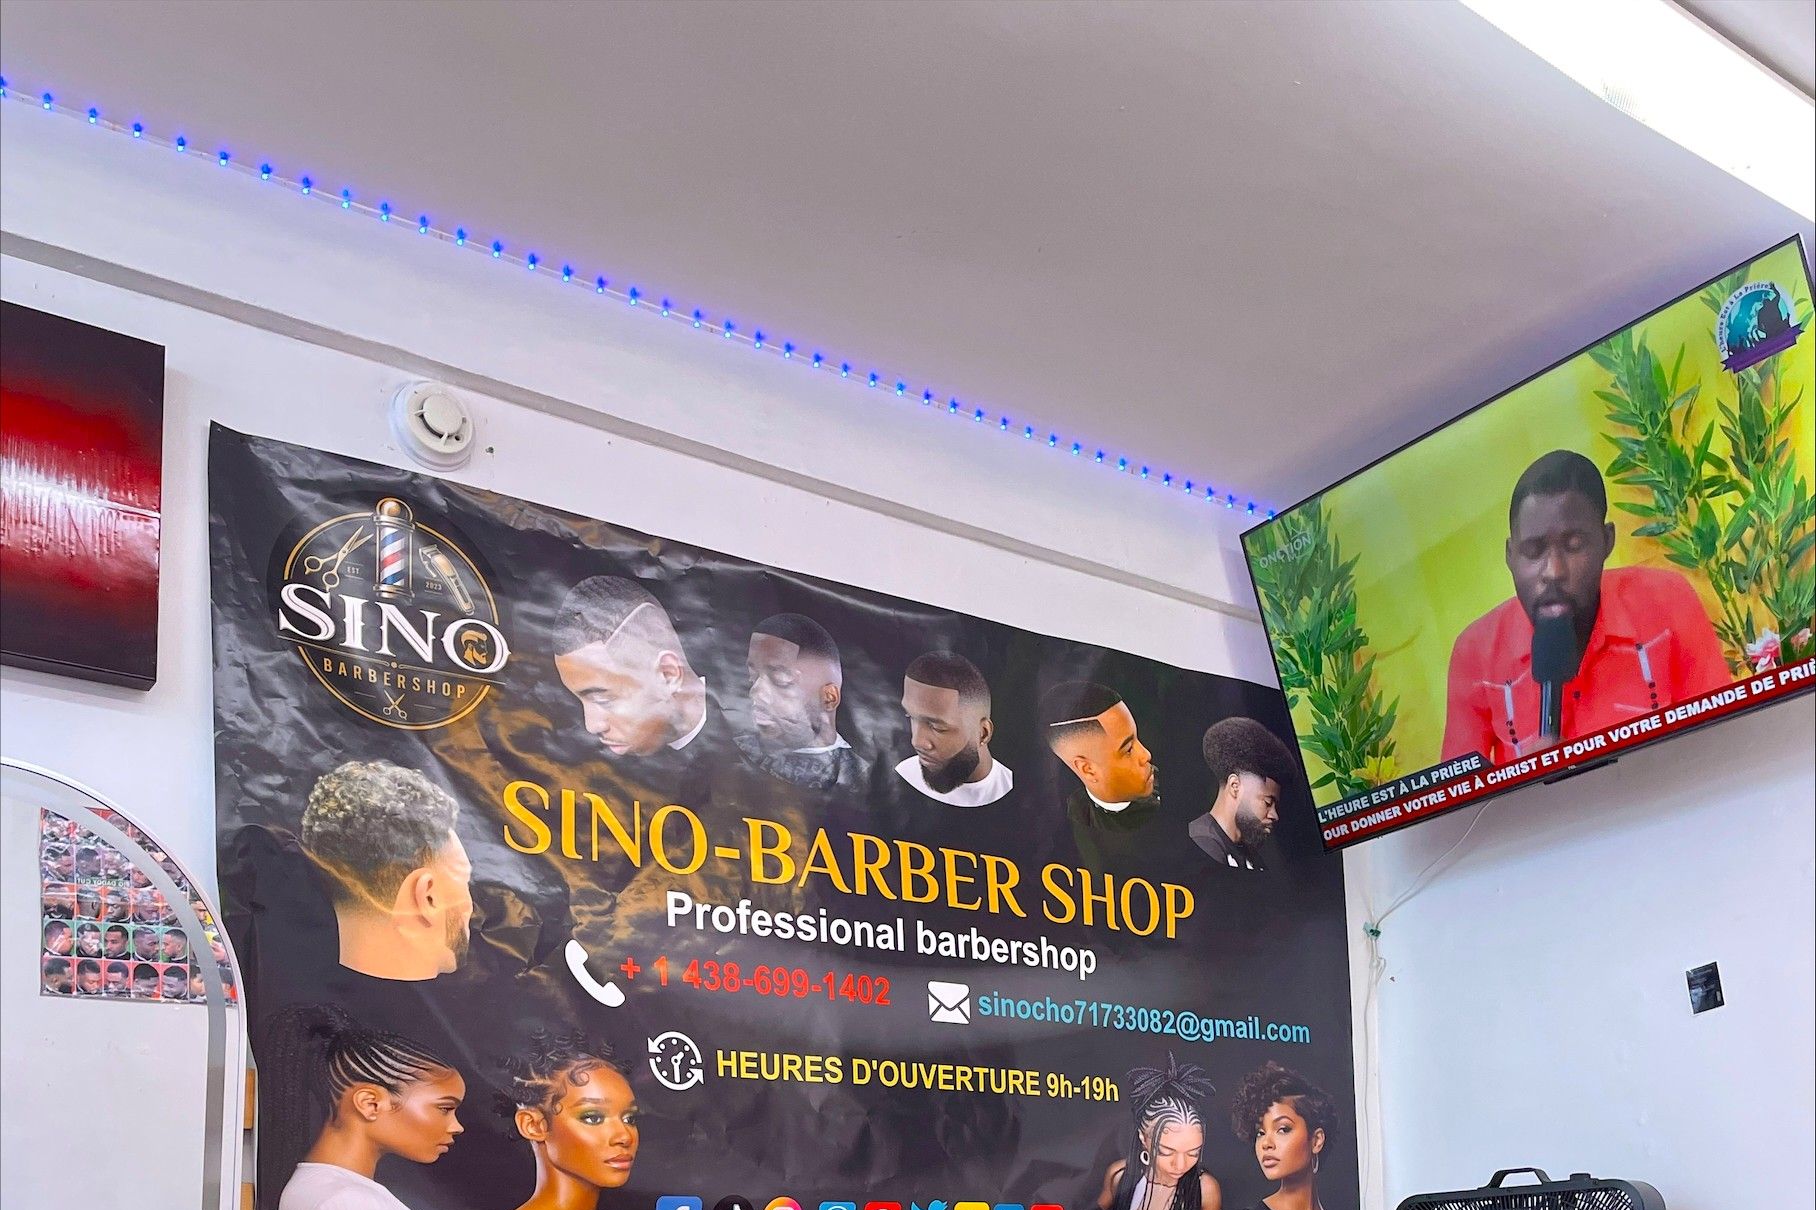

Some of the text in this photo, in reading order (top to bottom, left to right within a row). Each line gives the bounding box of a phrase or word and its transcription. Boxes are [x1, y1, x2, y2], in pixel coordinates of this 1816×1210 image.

[346, 566, 360, 575] EST
[279, 583, 512, 674] SINO
[323, 657, 467, 699] BARBERSHOP
[1323, 825, 1350, 841] OUR
[1351, 805, 1402, 832] DONNER
[1403, 790, 1447, 814] VOTRE
[1447, 783, 1471, 799] VIE
[1474, 775, 1485, 790] À
[1486, 756, 1538, 785] CHRIST
[1541, 749, 1560, 767] ET
[1562, 734, 1607, 759] POUR
[1607, 715, 1662, 743] VOTRE
[1664, 688, 1748, 724] DEMANDE
[1750, 676, 1776, 696] DE
[1318, 755, 1482, 824] L'HEURE EST À LA PRIÈRE
[502, 779, 1196, 939] SINO-BARBER SHOP
[666, 890, 1098, 980] Professional barbershop
[653, 955, 669, 986] 1
[682, 959, 891, 1005] 438-699-1402
[977, 991, 1311, 1044] sinocho71733082@gmail.com
[716, 1049, 1120, 1102] HEURES D'OUVERTURE 9h-19h
